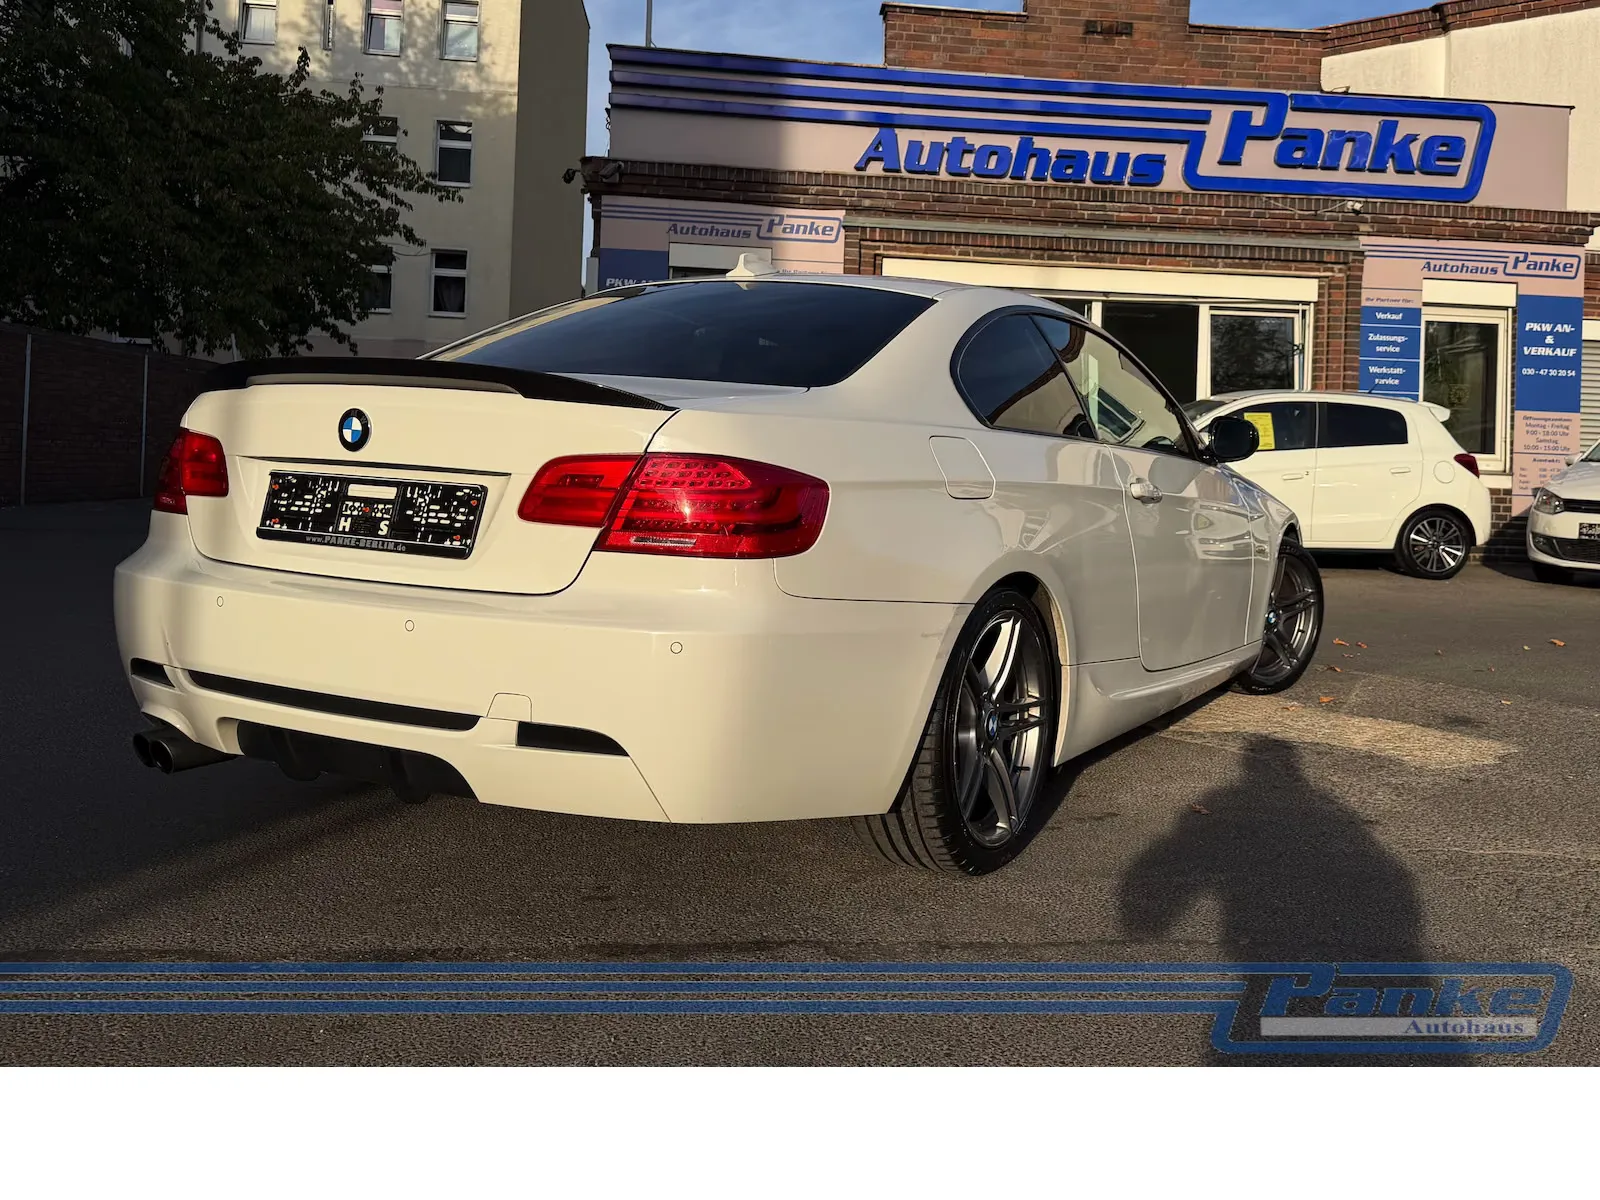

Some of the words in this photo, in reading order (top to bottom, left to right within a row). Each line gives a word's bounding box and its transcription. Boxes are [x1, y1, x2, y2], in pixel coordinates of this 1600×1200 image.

[855, 127, 1166, 187] Autohaus
[1217, 93, 1467, 178] Panke
[666, 222, 751, 239] Autohaus
[766, 214, 834, 237] Panke
[1421, 260, 1499, 276] Autohaus
[1511, 251, 1575, 273] Panke
[605, 277, 637, 287] PKW
[1375, 311, 1403, 321] Verkauf
[1524, 322, 1554, 332] PKW
[1553, 323, 1576, 333] AN-
[1368, 333, 1408, 343] Zulassungs-
[1544, 335, 1555, 344] &
[1375, 344, 1401, 353] service
[1523, 346, 1578, 357] VERKAUF
[1368, 365, 1407, 375] Werkstatt-
[1521, 367, 1535, 376] 030
[1539, 368, 1549, 376] 47
[1548, 368, 1558, 377] 30
[1557, 369, 1567, 377] 20
